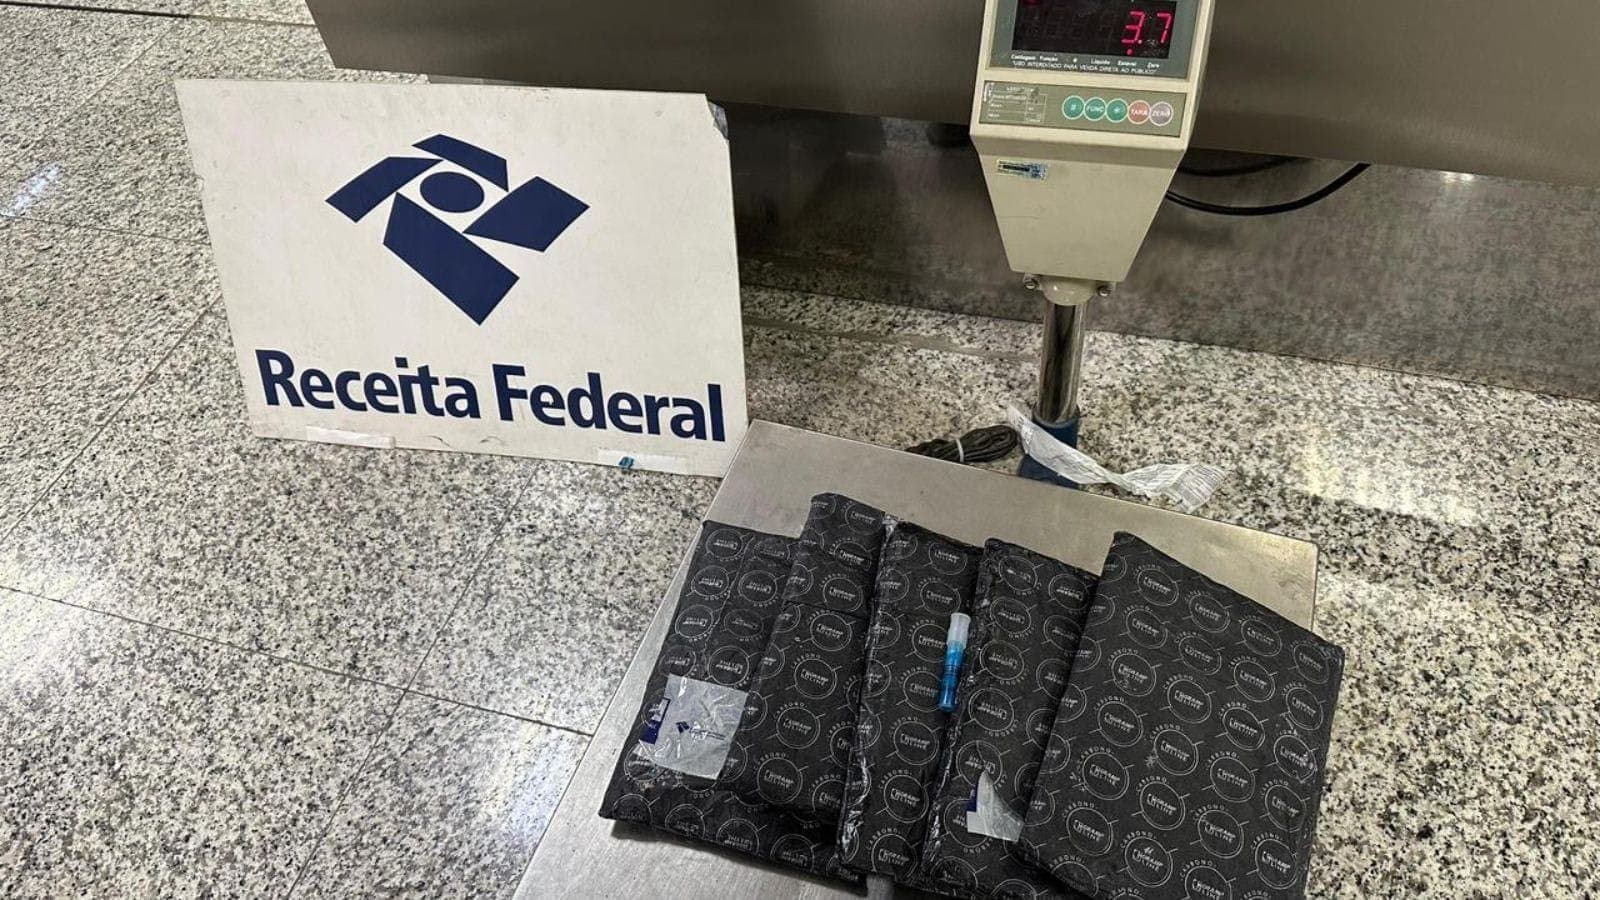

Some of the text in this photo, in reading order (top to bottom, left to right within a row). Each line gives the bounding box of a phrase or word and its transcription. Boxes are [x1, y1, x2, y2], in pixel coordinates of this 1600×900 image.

[1121, 10, 1174, 44] 3.7
[255, 349, 725, 442] Receita Federal
